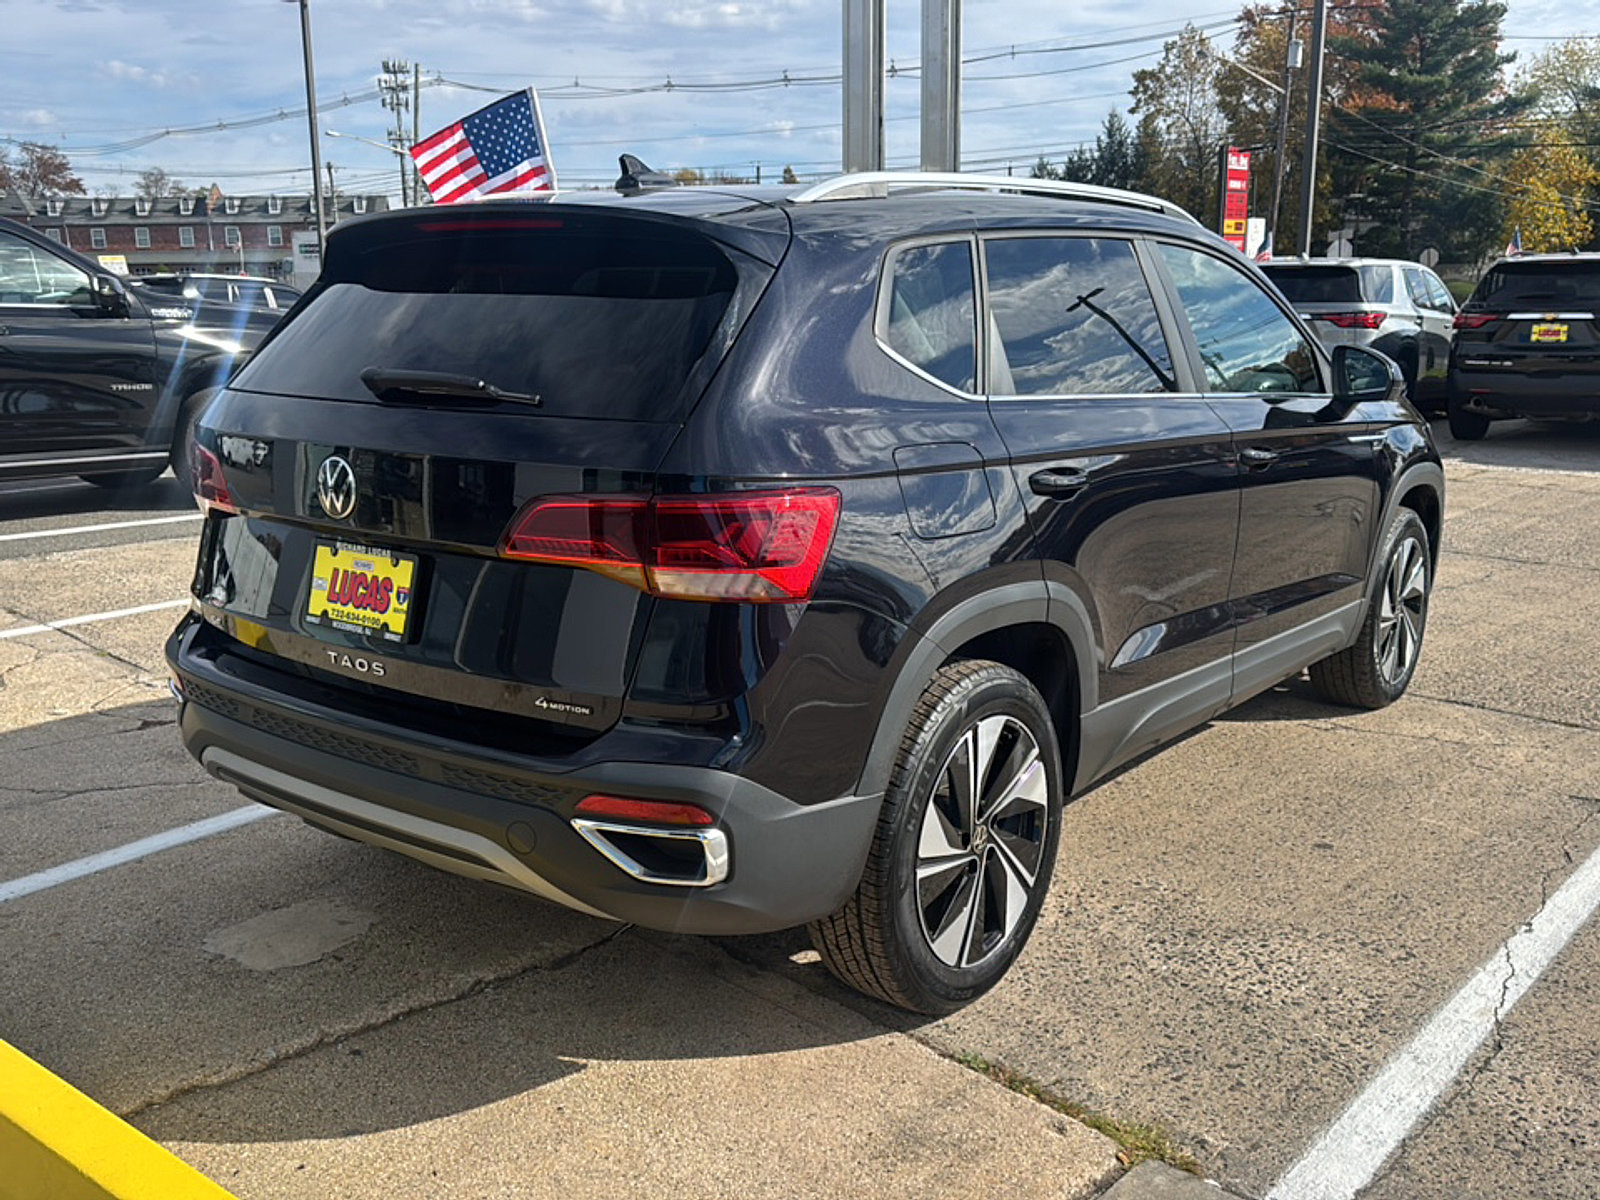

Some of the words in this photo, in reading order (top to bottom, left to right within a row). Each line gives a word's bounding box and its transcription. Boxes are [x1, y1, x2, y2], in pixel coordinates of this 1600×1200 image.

[327, 567, 394, 614] LUCAS
[327, 651, 386, 676] TAOS
[534, 696, 591, 715] 4MOTION
